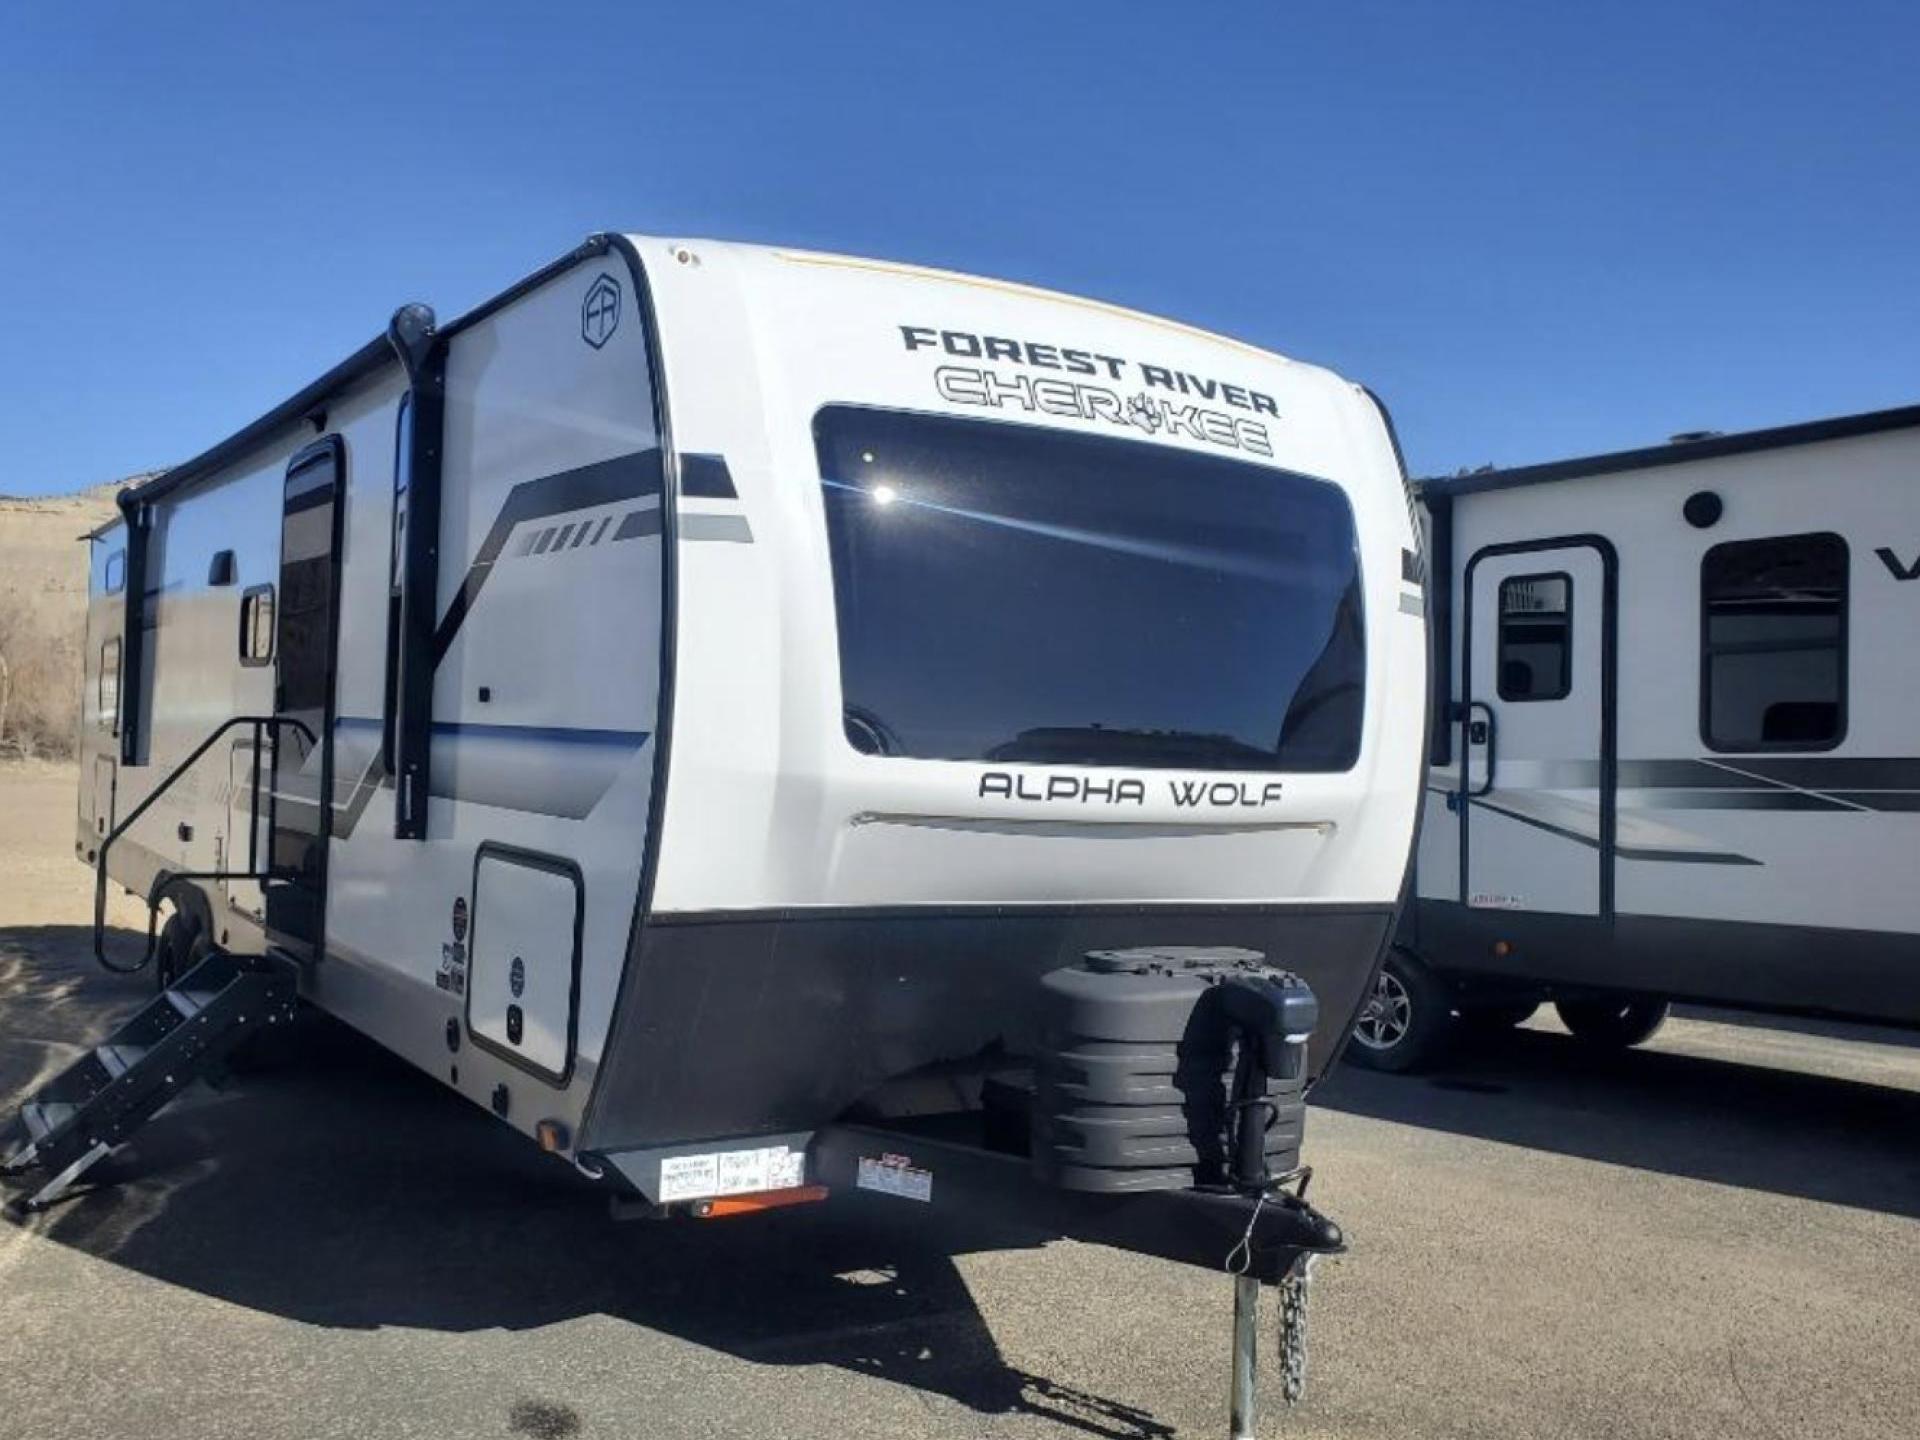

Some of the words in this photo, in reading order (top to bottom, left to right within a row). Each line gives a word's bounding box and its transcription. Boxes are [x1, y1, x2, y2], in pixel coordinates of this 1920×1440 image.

[898, 325, 1126, 379] FOREST
[1138, 362, 1281, 418] RIVER
[978, 772, 1146, 806] ALPHA
[1169, 780, 1283, 808] WOLF
